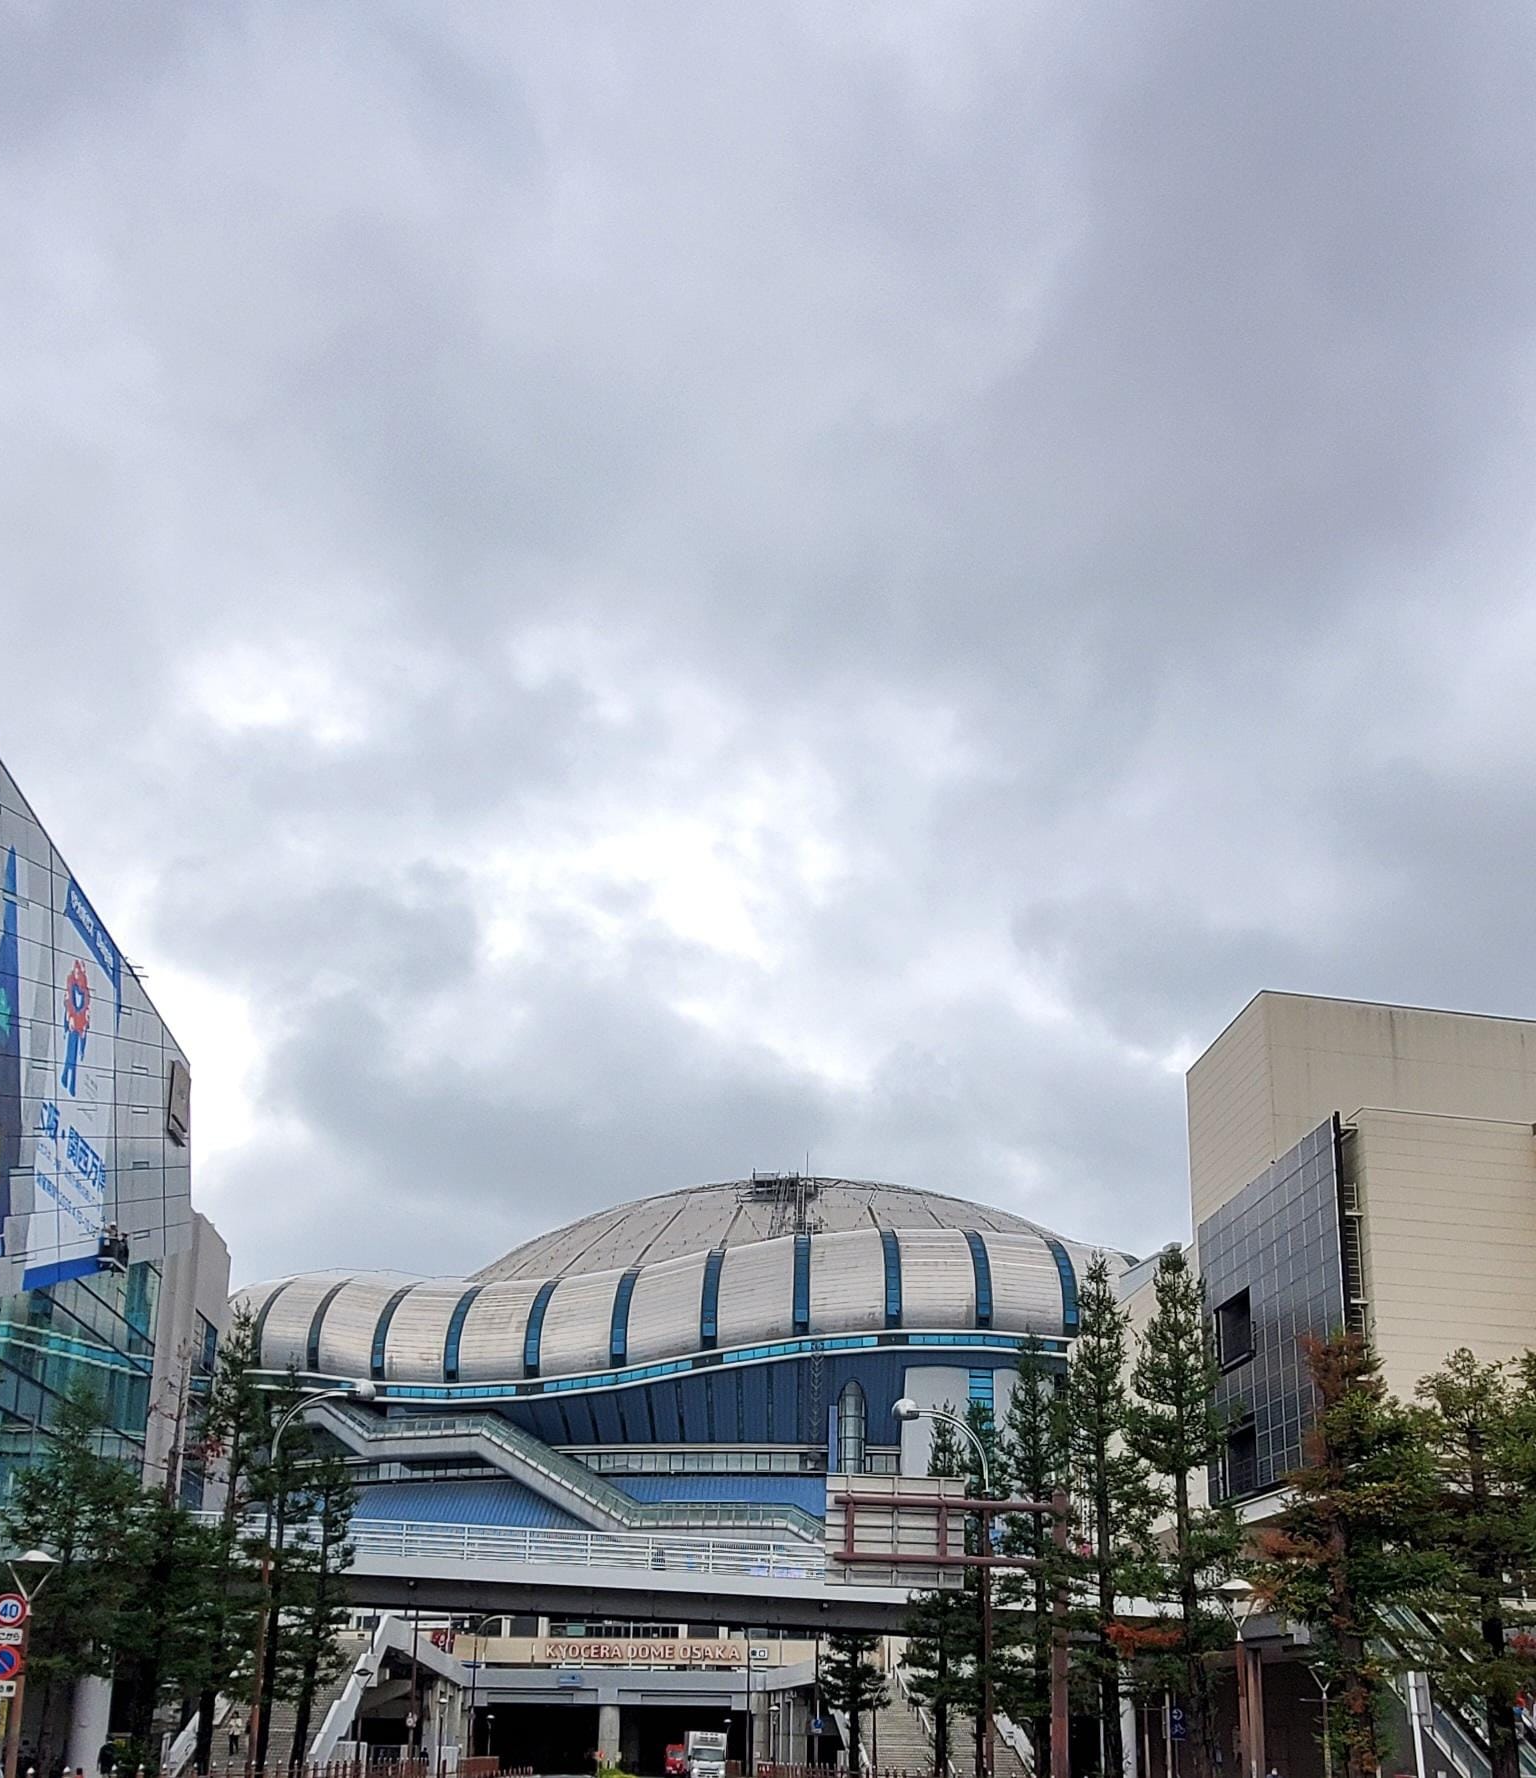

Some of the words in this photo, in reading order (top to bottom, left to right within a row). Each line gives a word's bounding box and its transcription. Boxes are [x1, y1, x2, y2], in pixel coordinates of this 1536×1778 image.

[0, 1603, 19, 1618] 40
[545, 1643, 622, 1660] KYOCERA
[626, 1643, 676, 1660] DOME
[679, 1644, 741, 1661] OSAKA
